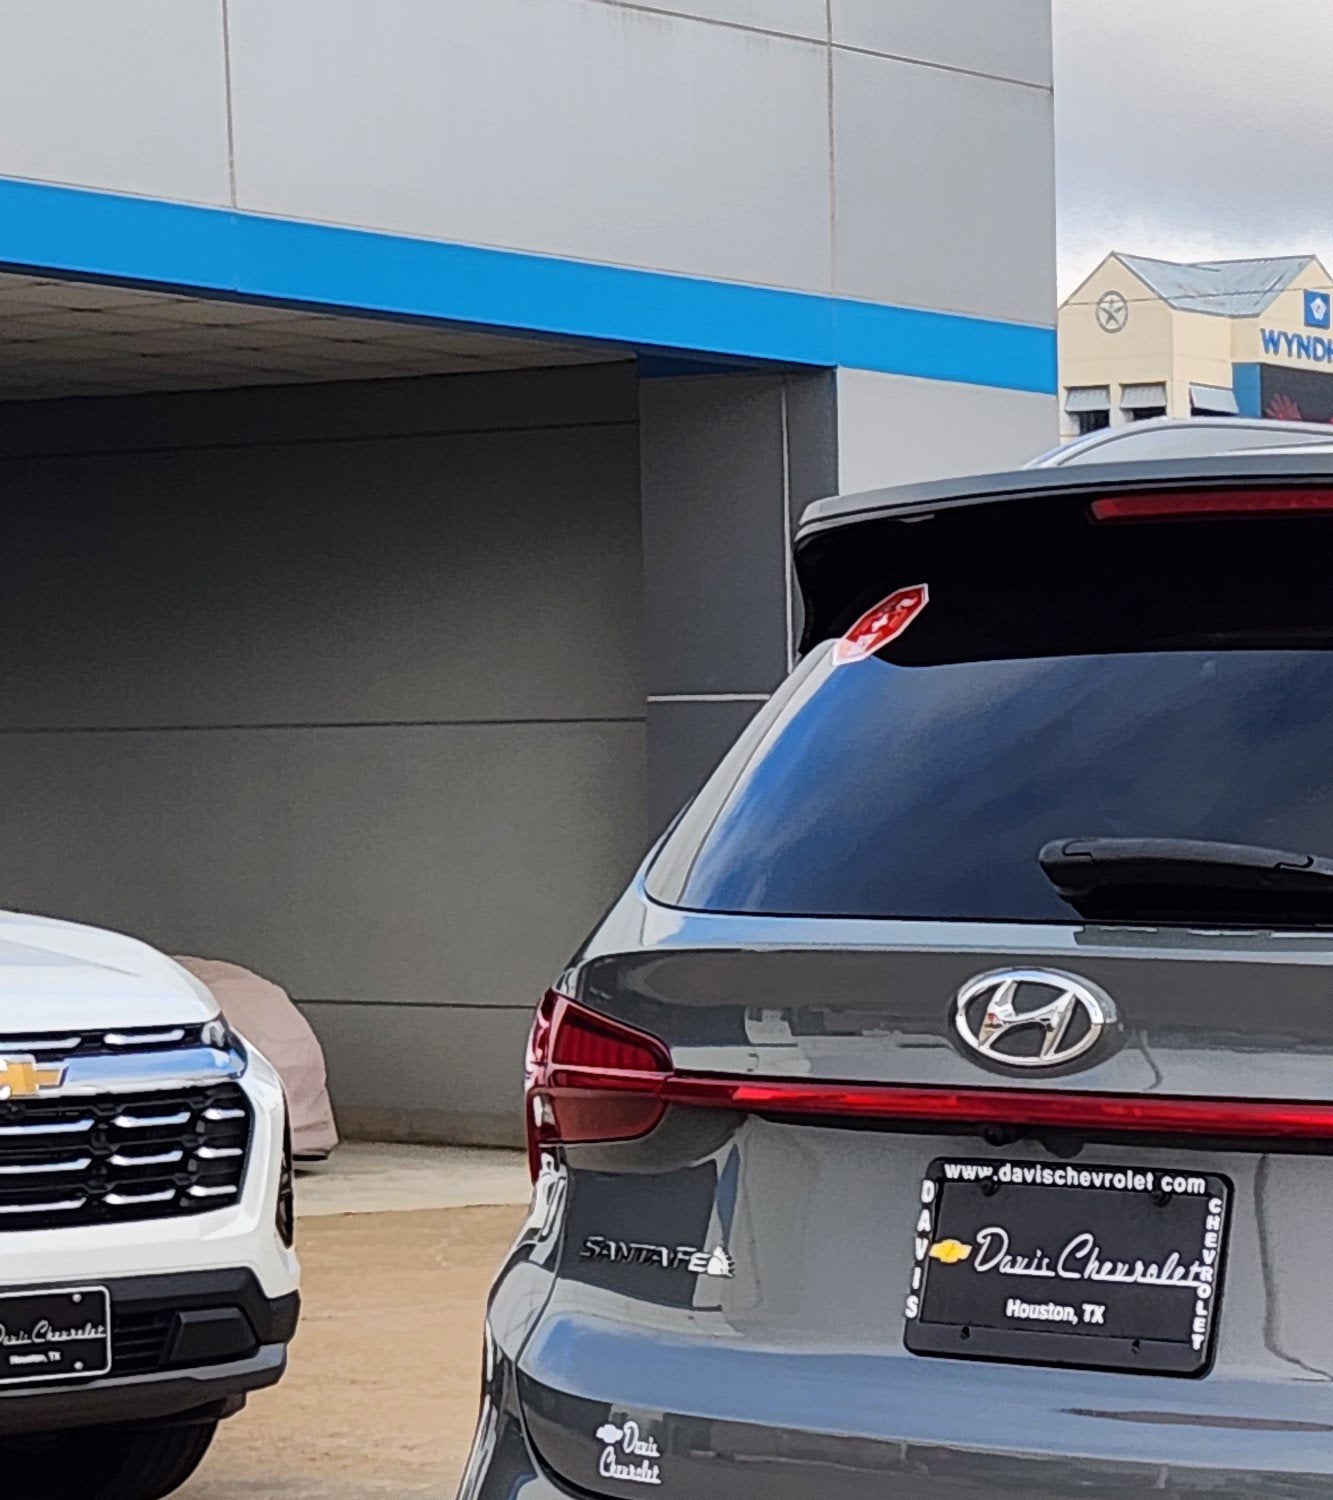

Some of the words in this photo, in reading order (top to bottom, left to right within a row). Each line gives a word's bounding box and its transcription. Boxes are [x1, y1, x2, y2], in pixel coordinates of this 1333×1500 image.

[905, 1180, 934, 1318] DAVIS
[974, 1227, 1056, 1278] Davis
[1057, 1233, 1204, 1288] Chevrolet
[1191, 1197, 1223, 1350] CHEVROLET
[1006, 1298, 1078, 1326] Houston,
[1082, 1303, 1106, 1325] TX
